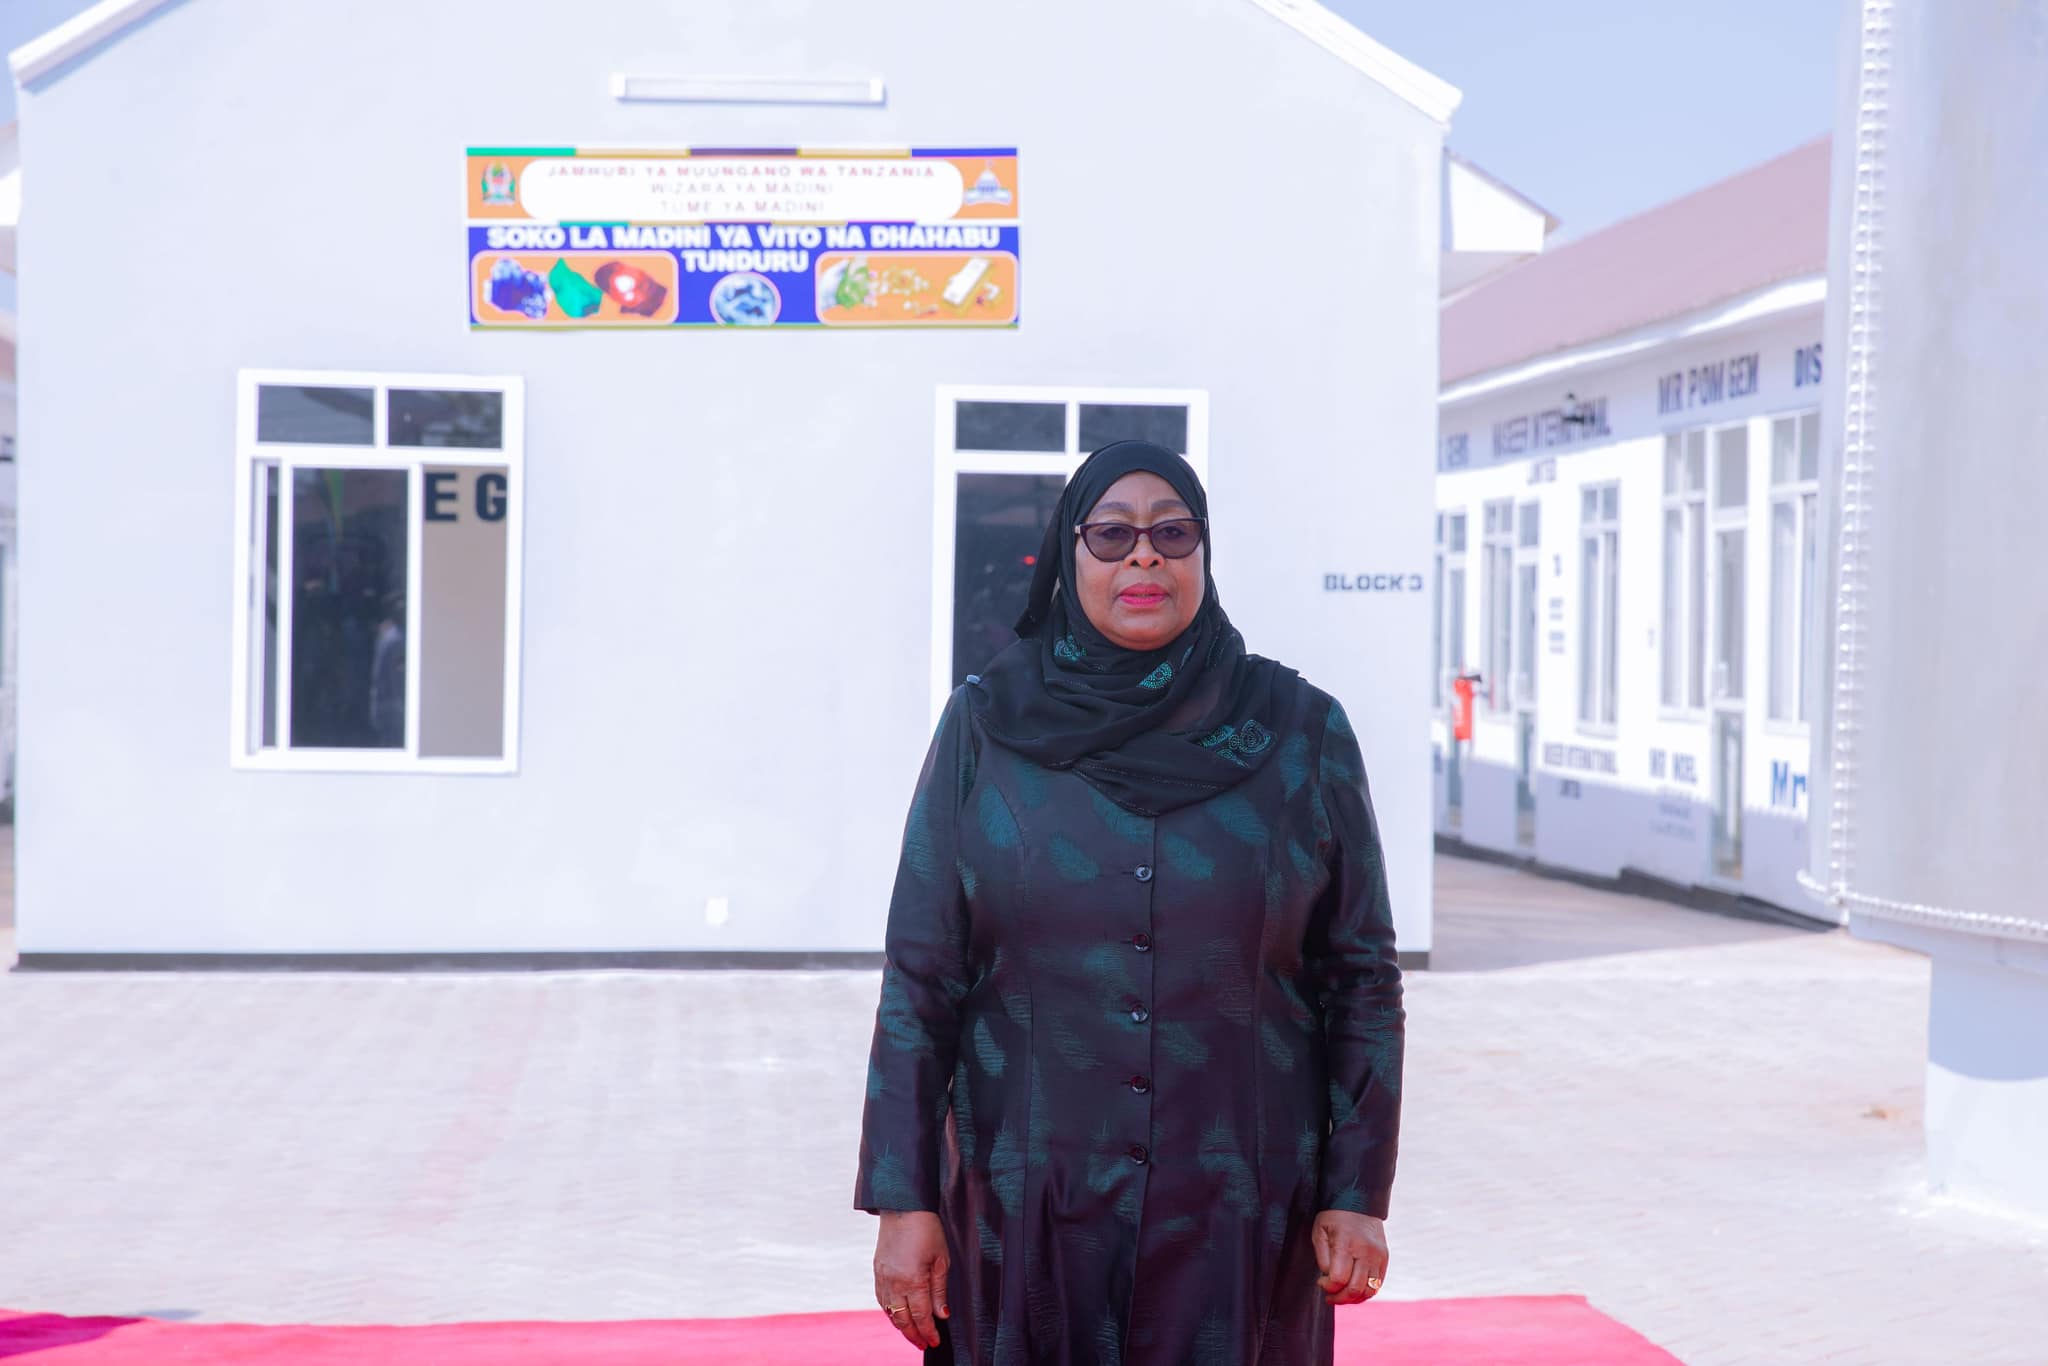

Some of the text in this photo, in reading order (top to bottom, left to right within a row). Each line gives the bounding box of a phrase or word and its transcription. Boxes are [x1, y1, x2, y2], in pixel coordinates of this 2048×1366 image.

[549, 166, 936, 177] JAMHURI YA MUUNGANO WA TANZANIA
[765, 183, 834, 194] MADINI
[724, 201, 745, 213] YA
[754, 201, 826, 213] MADINI
[487, 225, 1001, 249] SOKO LA MADINI YA VITO NA DHAHABU
[681, 250, 809, 273] TUNDURU
